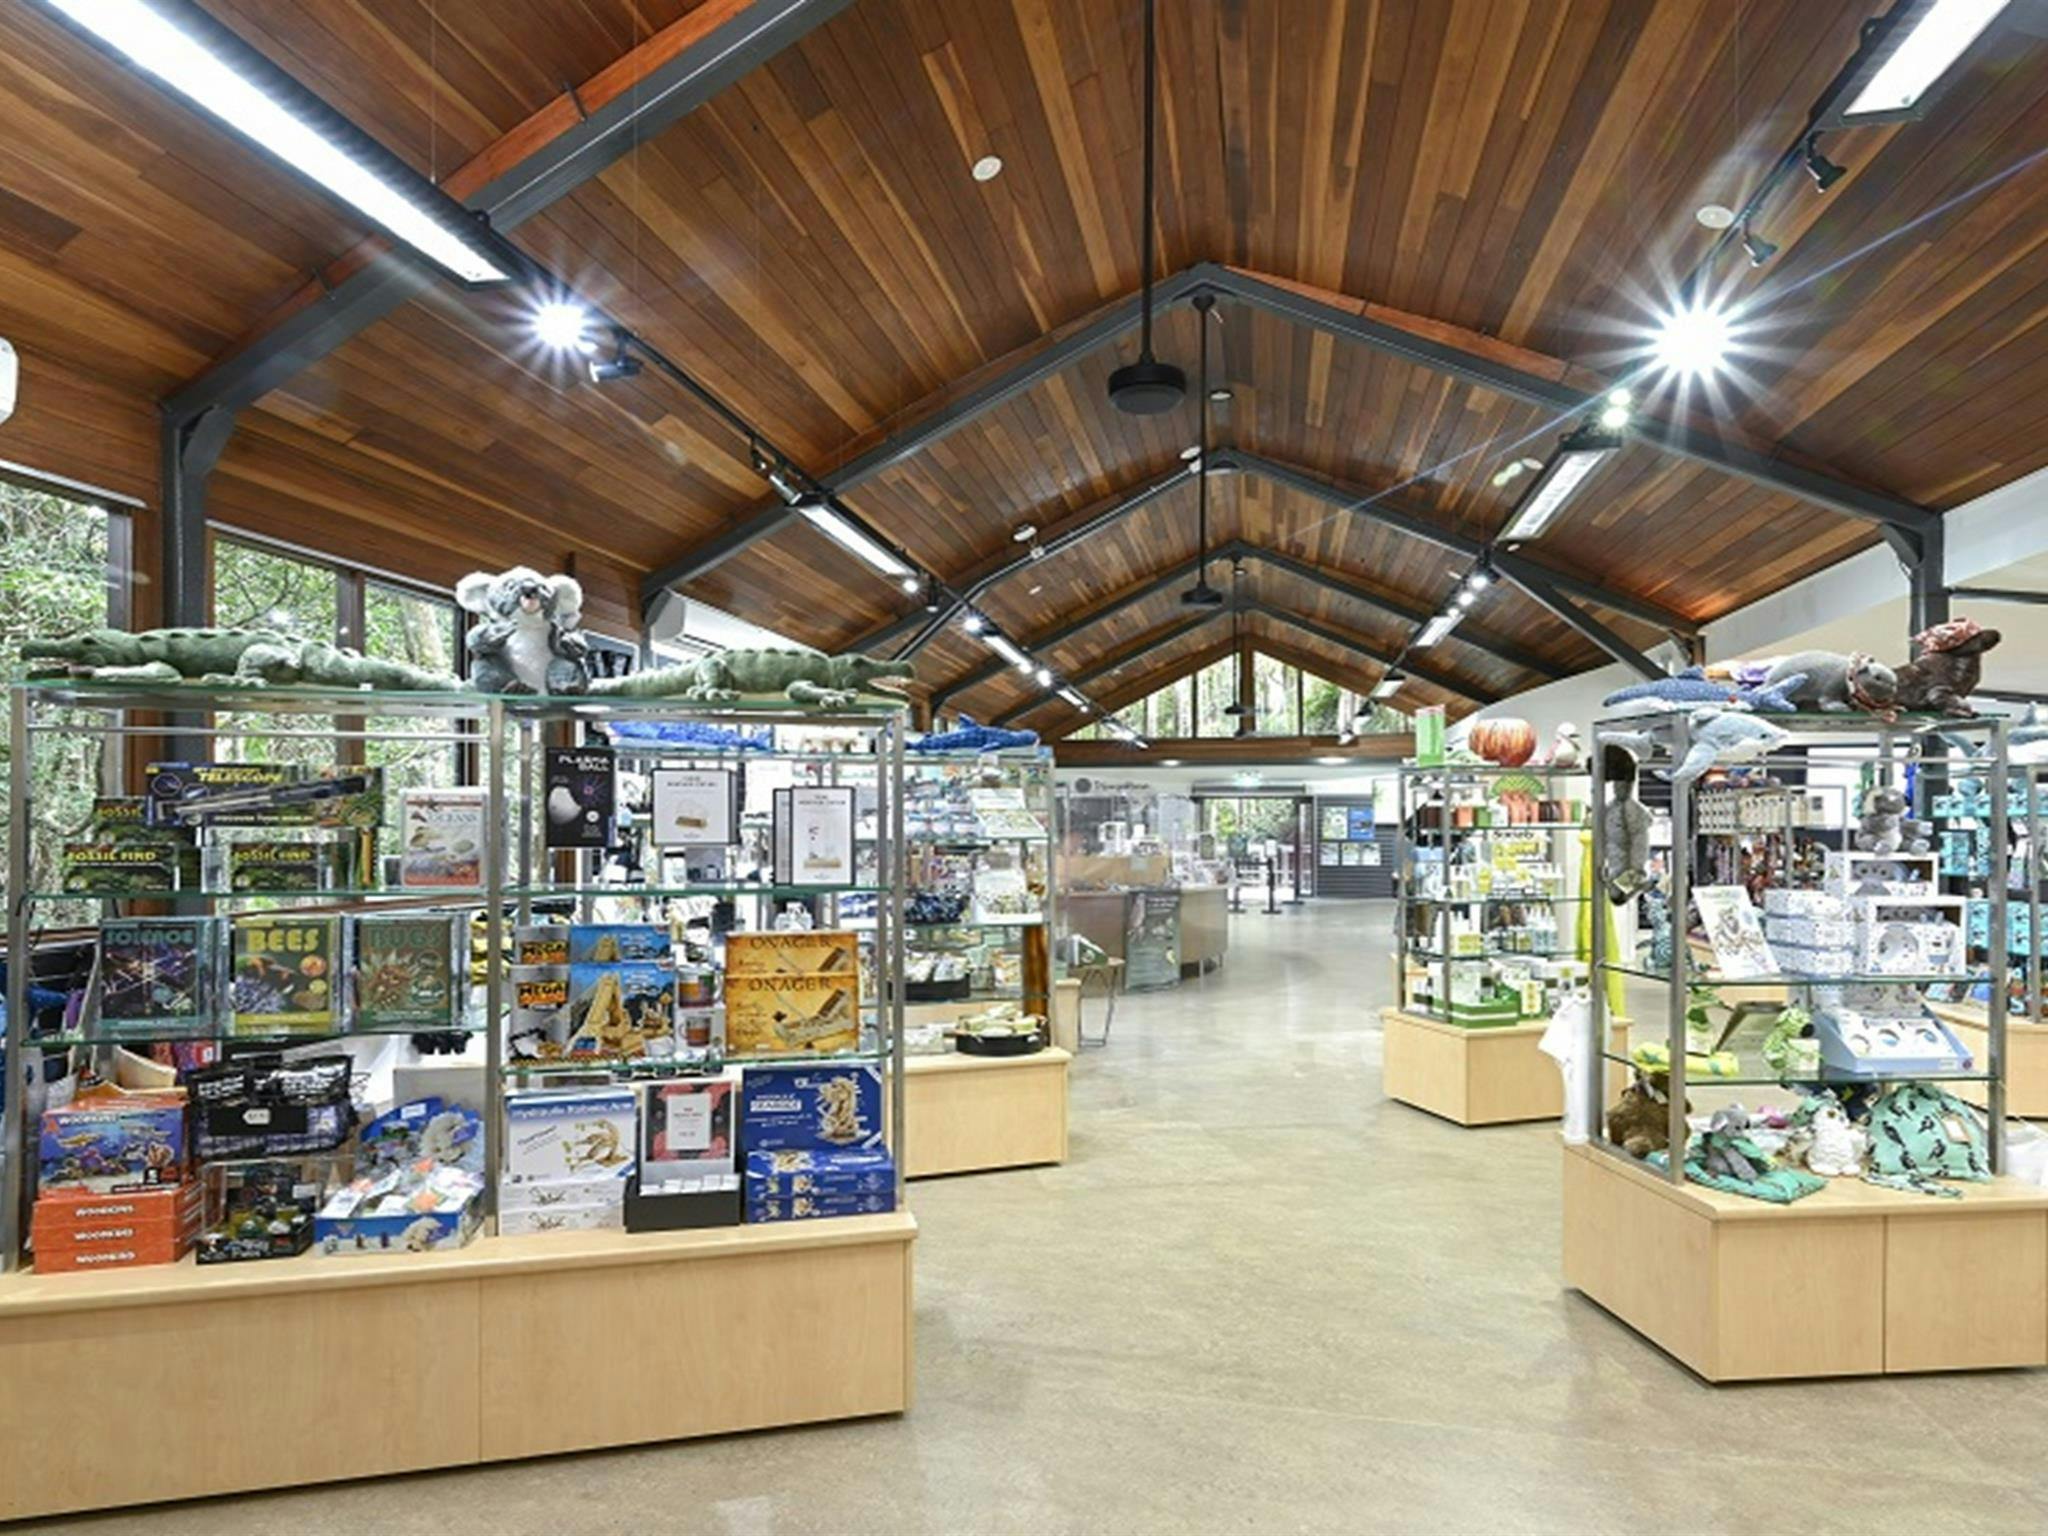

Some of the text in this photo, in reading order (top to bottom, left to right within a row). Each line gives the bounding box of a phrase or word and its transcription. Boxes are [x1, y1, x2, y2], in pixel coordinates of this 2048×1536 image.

[558, 755, 610, 764] PLASMA
[578, 763, 610, 772] BALL
[67, 851, 157, 862] FOSSIL FIND
[234, 852, 277, 862] FOSSIL
[248, 928, 320, 952] BEES
[370, 925, 442, 949] BUGS
[749, 935, 832, 949] ONAGER
[748, 977, 832, 992] ONAGER
